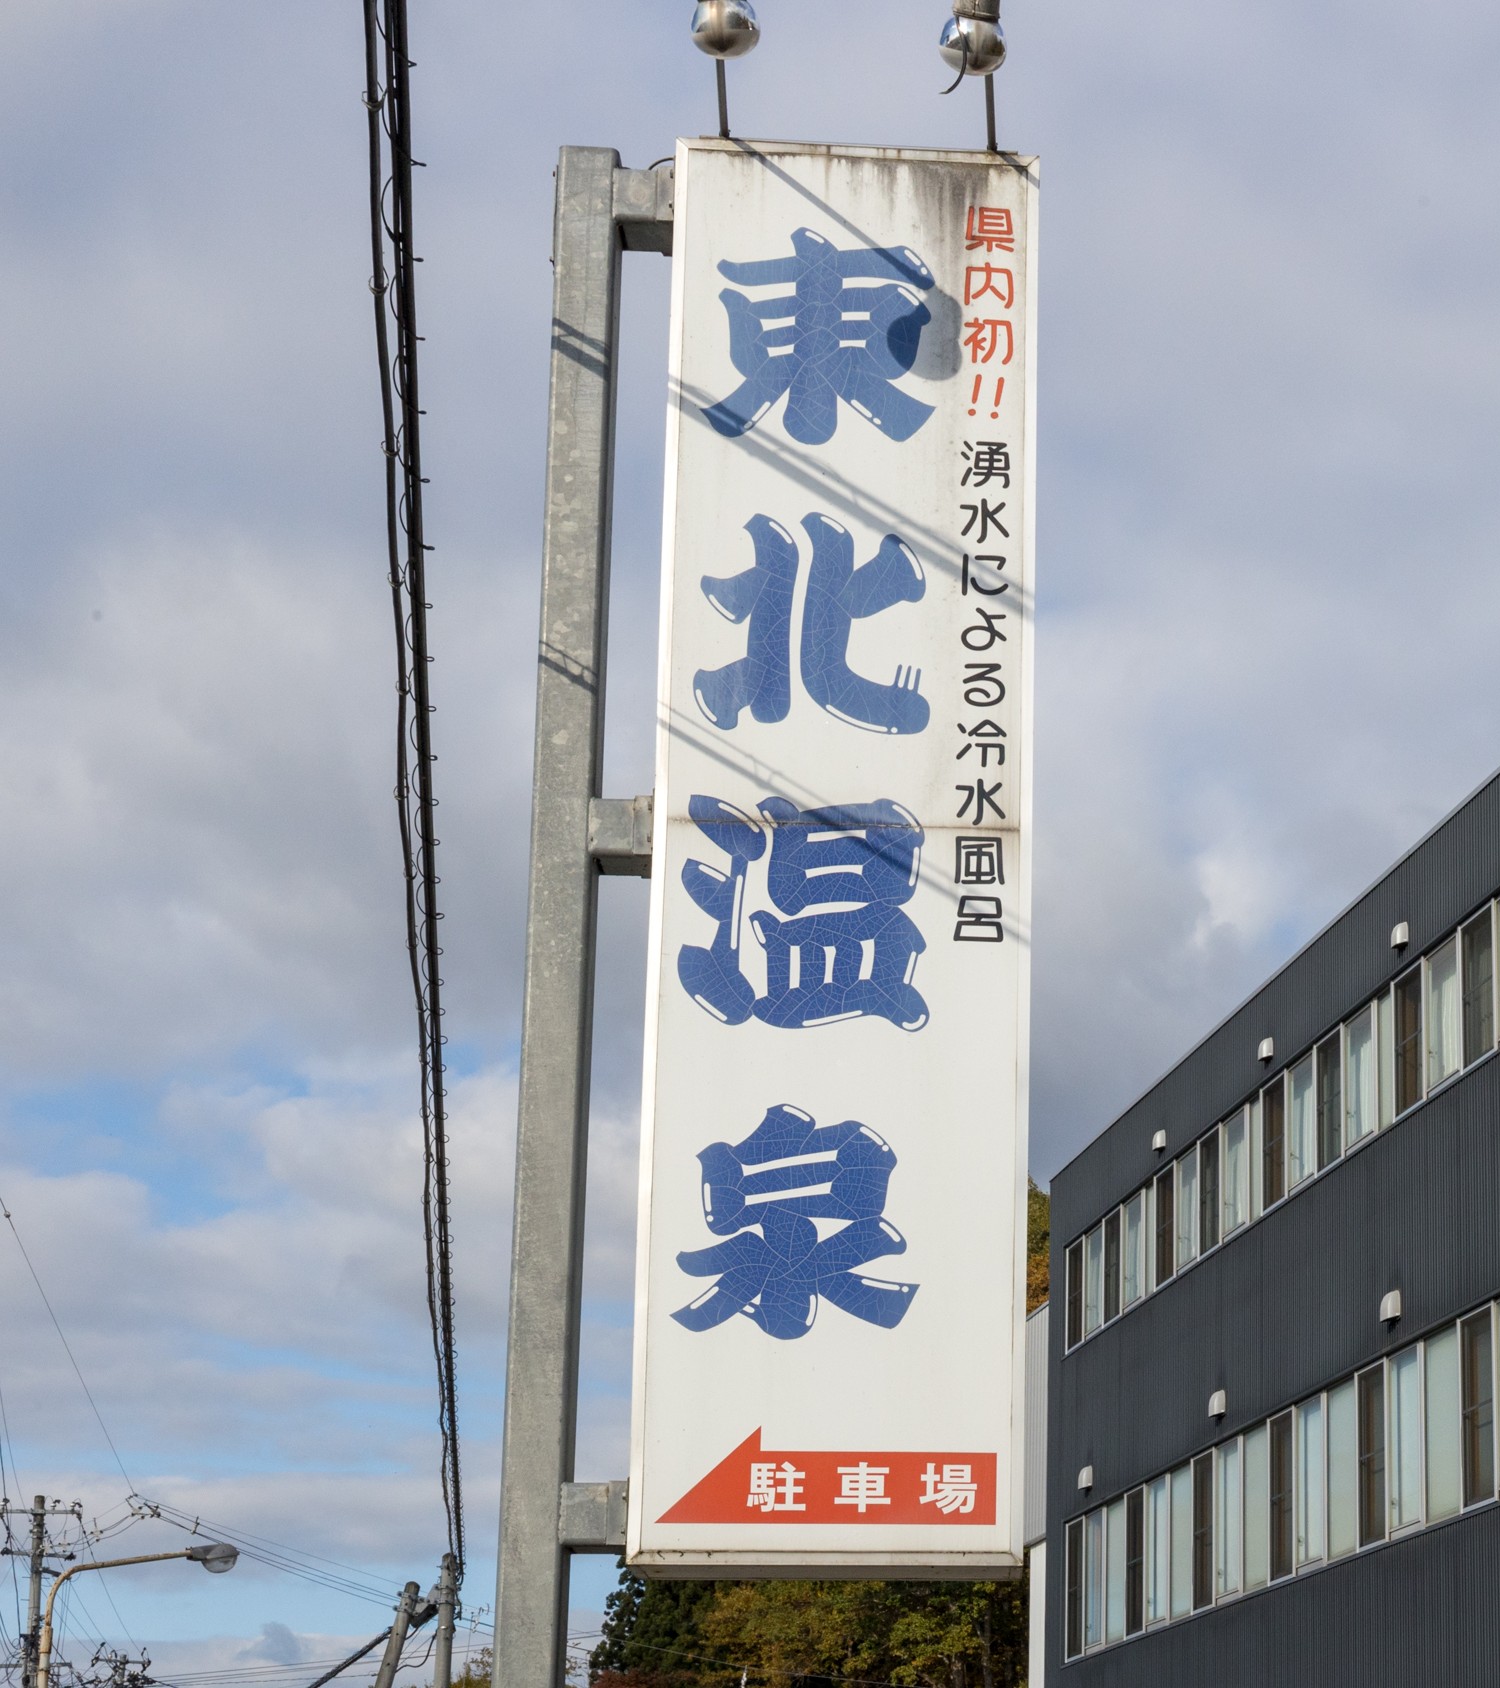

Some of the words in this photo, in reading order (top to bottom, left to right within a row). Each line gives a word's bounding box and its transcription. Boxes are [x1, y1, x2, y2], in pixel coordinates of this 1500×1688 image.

[671, 227, 936, 1340] 東北温泉
[746, 1461, 978, 1515] 駐車場
